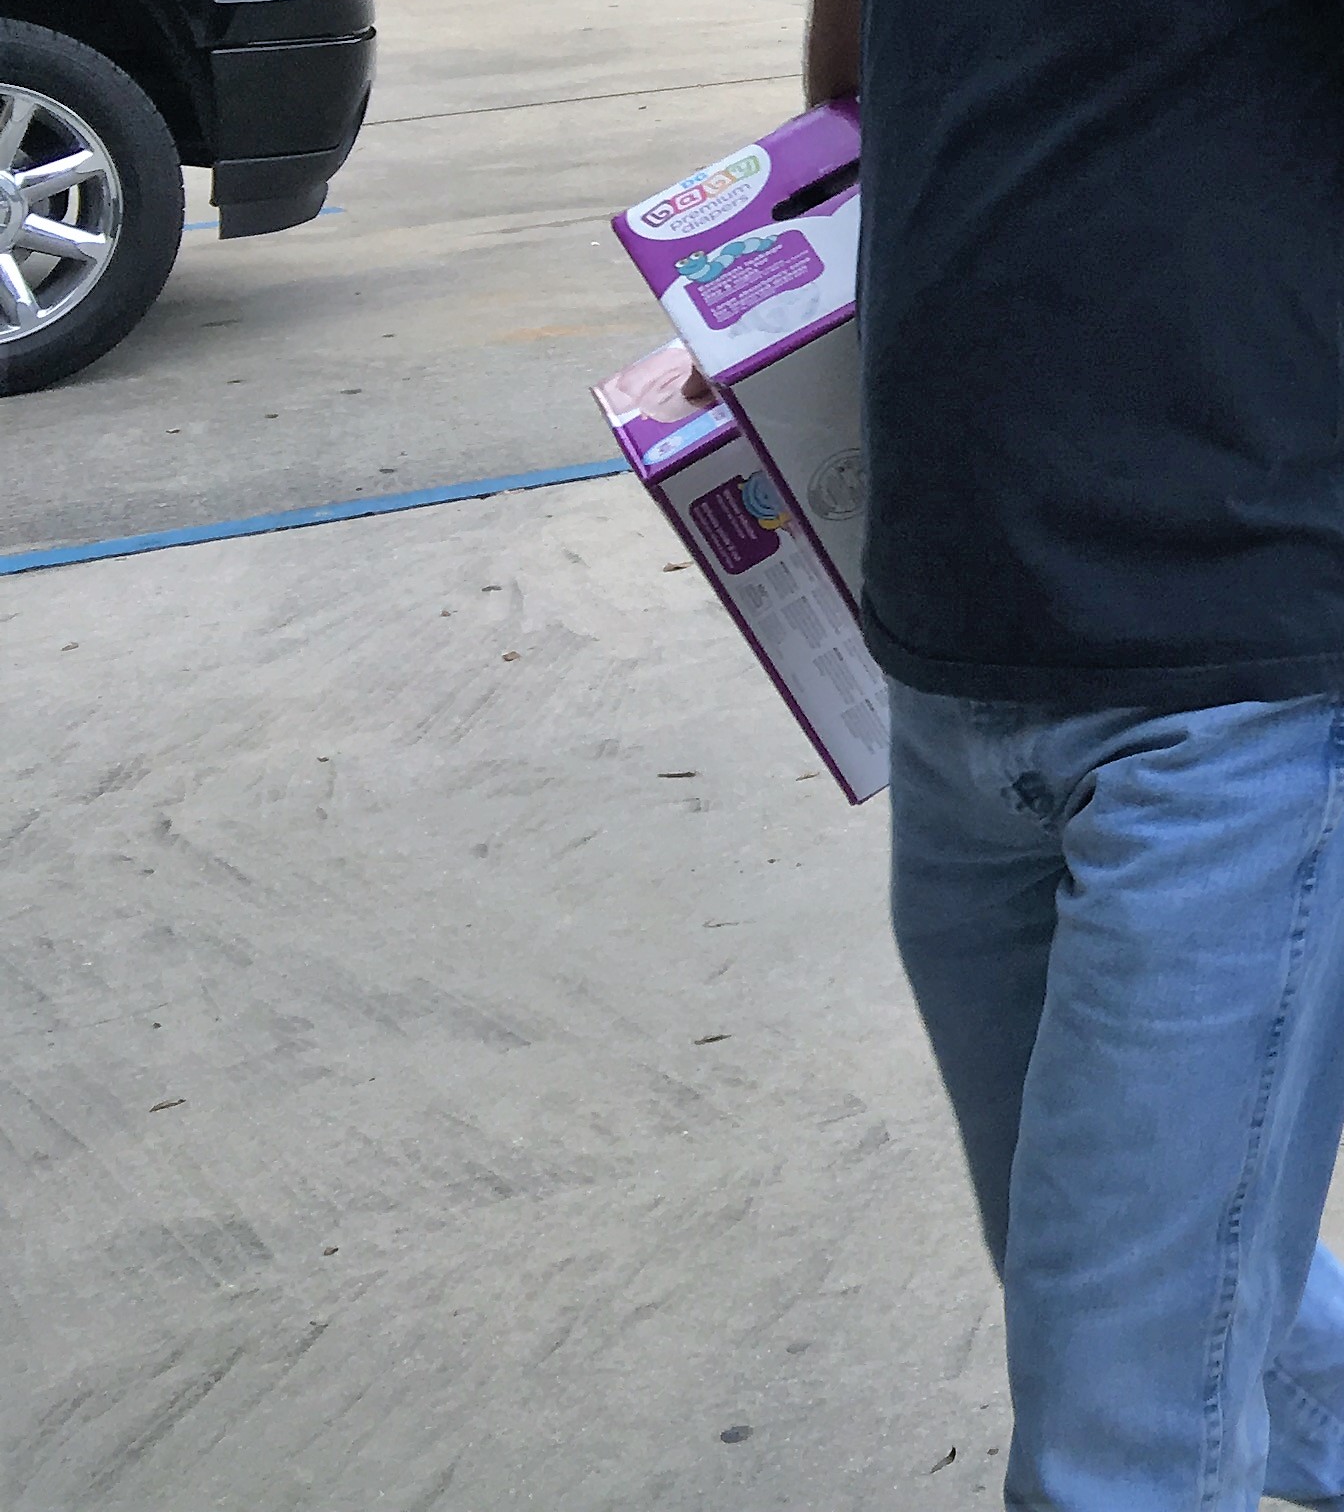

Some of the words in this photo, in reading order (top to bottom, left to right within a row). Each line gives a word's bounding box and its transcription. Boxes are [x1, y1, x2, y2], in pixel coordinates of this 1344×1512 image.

[645, 155, 760, 225] baby
[669, 183, 751, 232] premium
[681, 194, 749, 234] diapers
